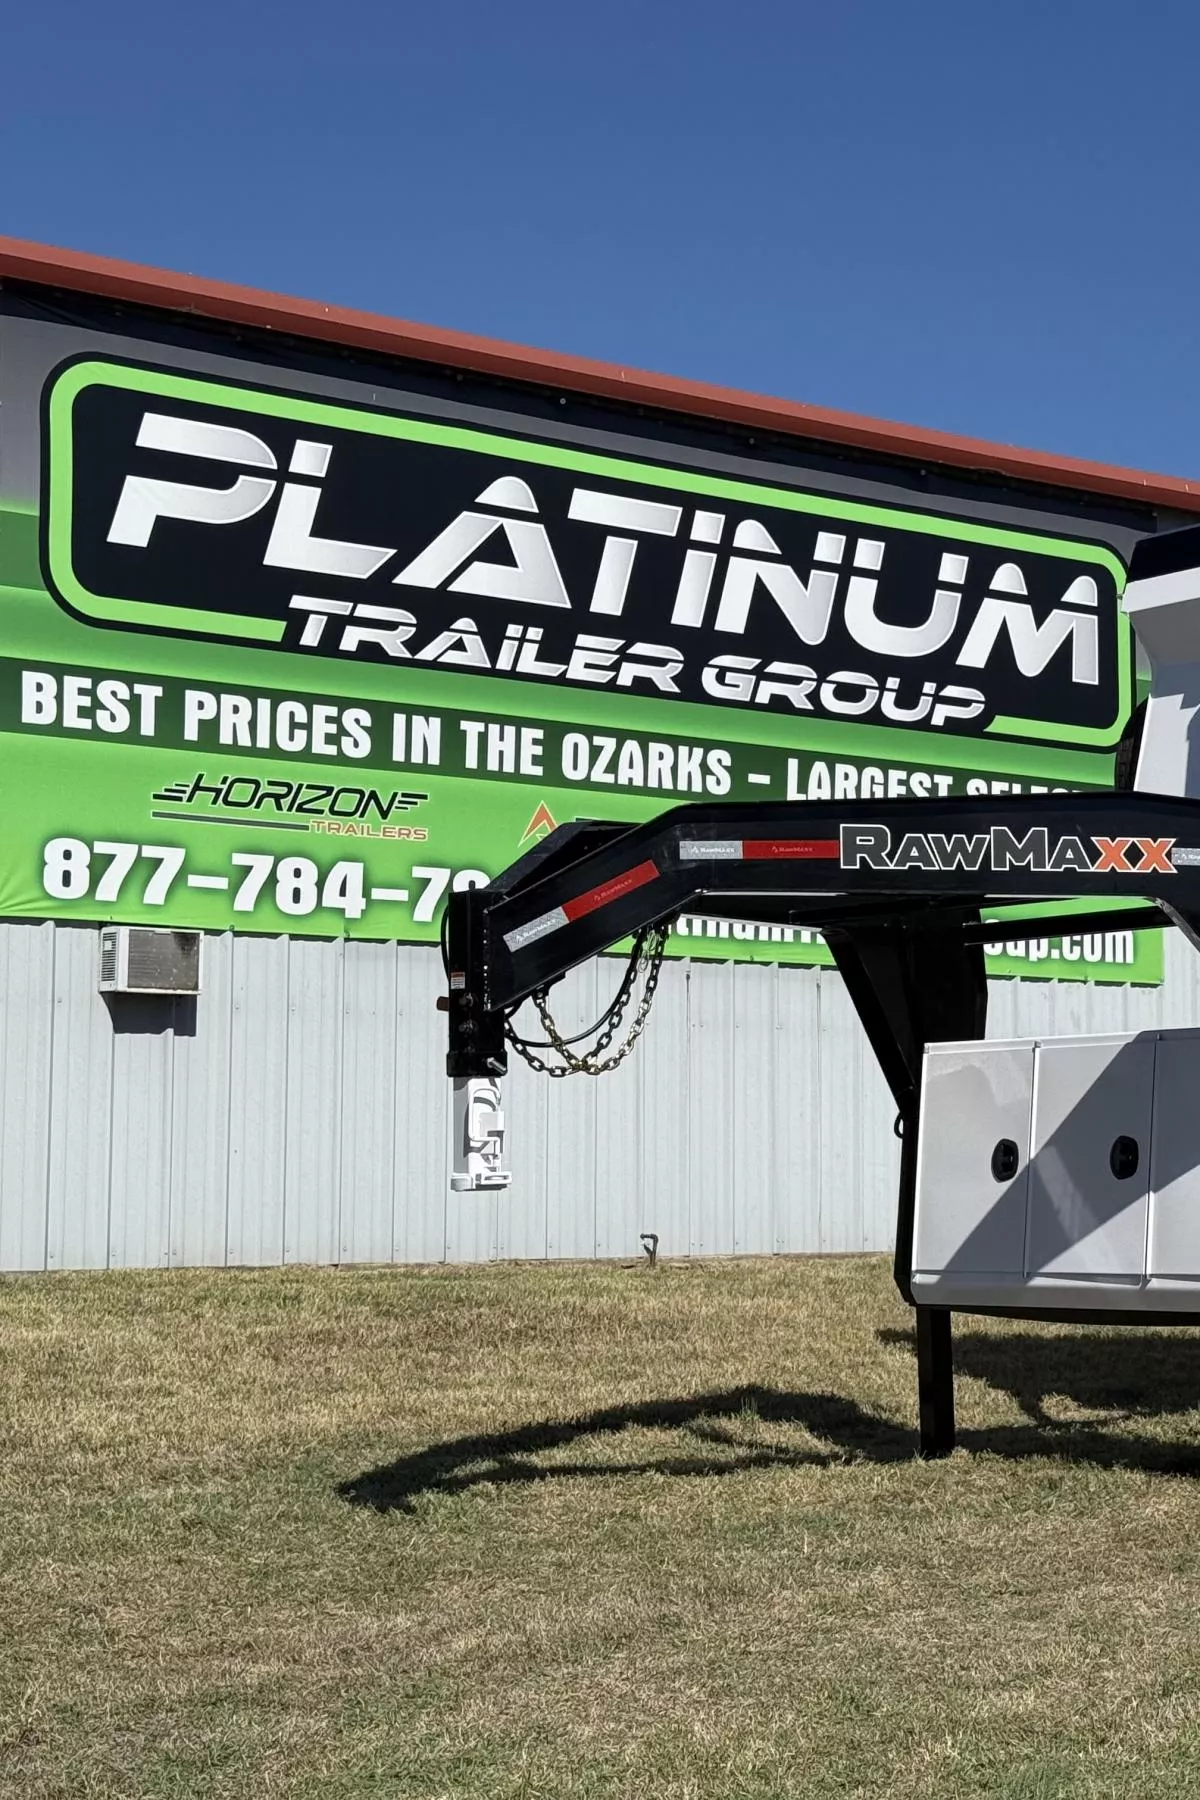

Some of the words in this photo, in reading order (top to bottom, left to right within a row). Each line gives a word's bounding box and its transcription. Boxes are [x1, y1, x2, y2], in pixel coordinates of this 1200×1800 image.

[106, 411, 1099, 686] PLATINUM
[288, 594, 685, 694] TRAILER
[701, 654, 986, 727] GROUP
[20, 670, 163, 737] BEST
[183, 688, 372, 759] PRICES
[392, 712, 442, 766] IN
[460, 720, 545, 776] THE
[561, 732, 732, 797] OZARKS
[185, 773, 399, 821] HORIZON
[311, 820, 428, 842] TRAILERS
